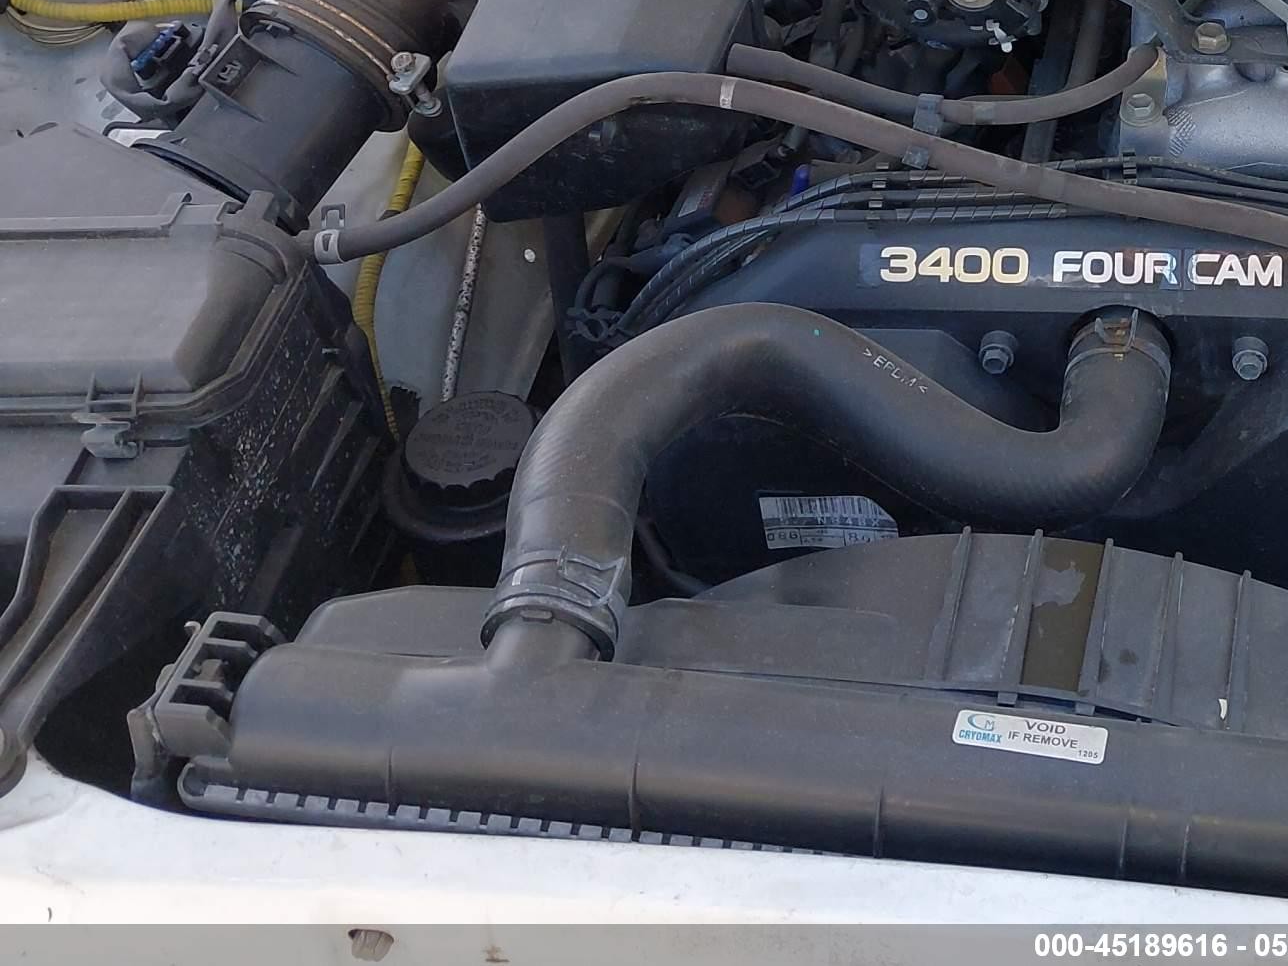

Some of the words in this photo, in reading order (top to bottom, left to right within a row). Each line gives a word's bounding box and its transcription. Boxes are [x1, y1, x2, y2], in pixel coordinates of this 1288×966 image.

[879, 246, 1029, 284] 3400
[1052, 250, 1177, 285] FOUR
[1187, 253, 1283, 287] CAM
[1025, 720, 1066, 734] VOID
[958, 729, 1003, 744] CRYOMAX
[1008, 730, 1019, 740] IF
[1022, 732, 1079, 749] REMOVE
[1078, 749, 1099, 759] 1205
